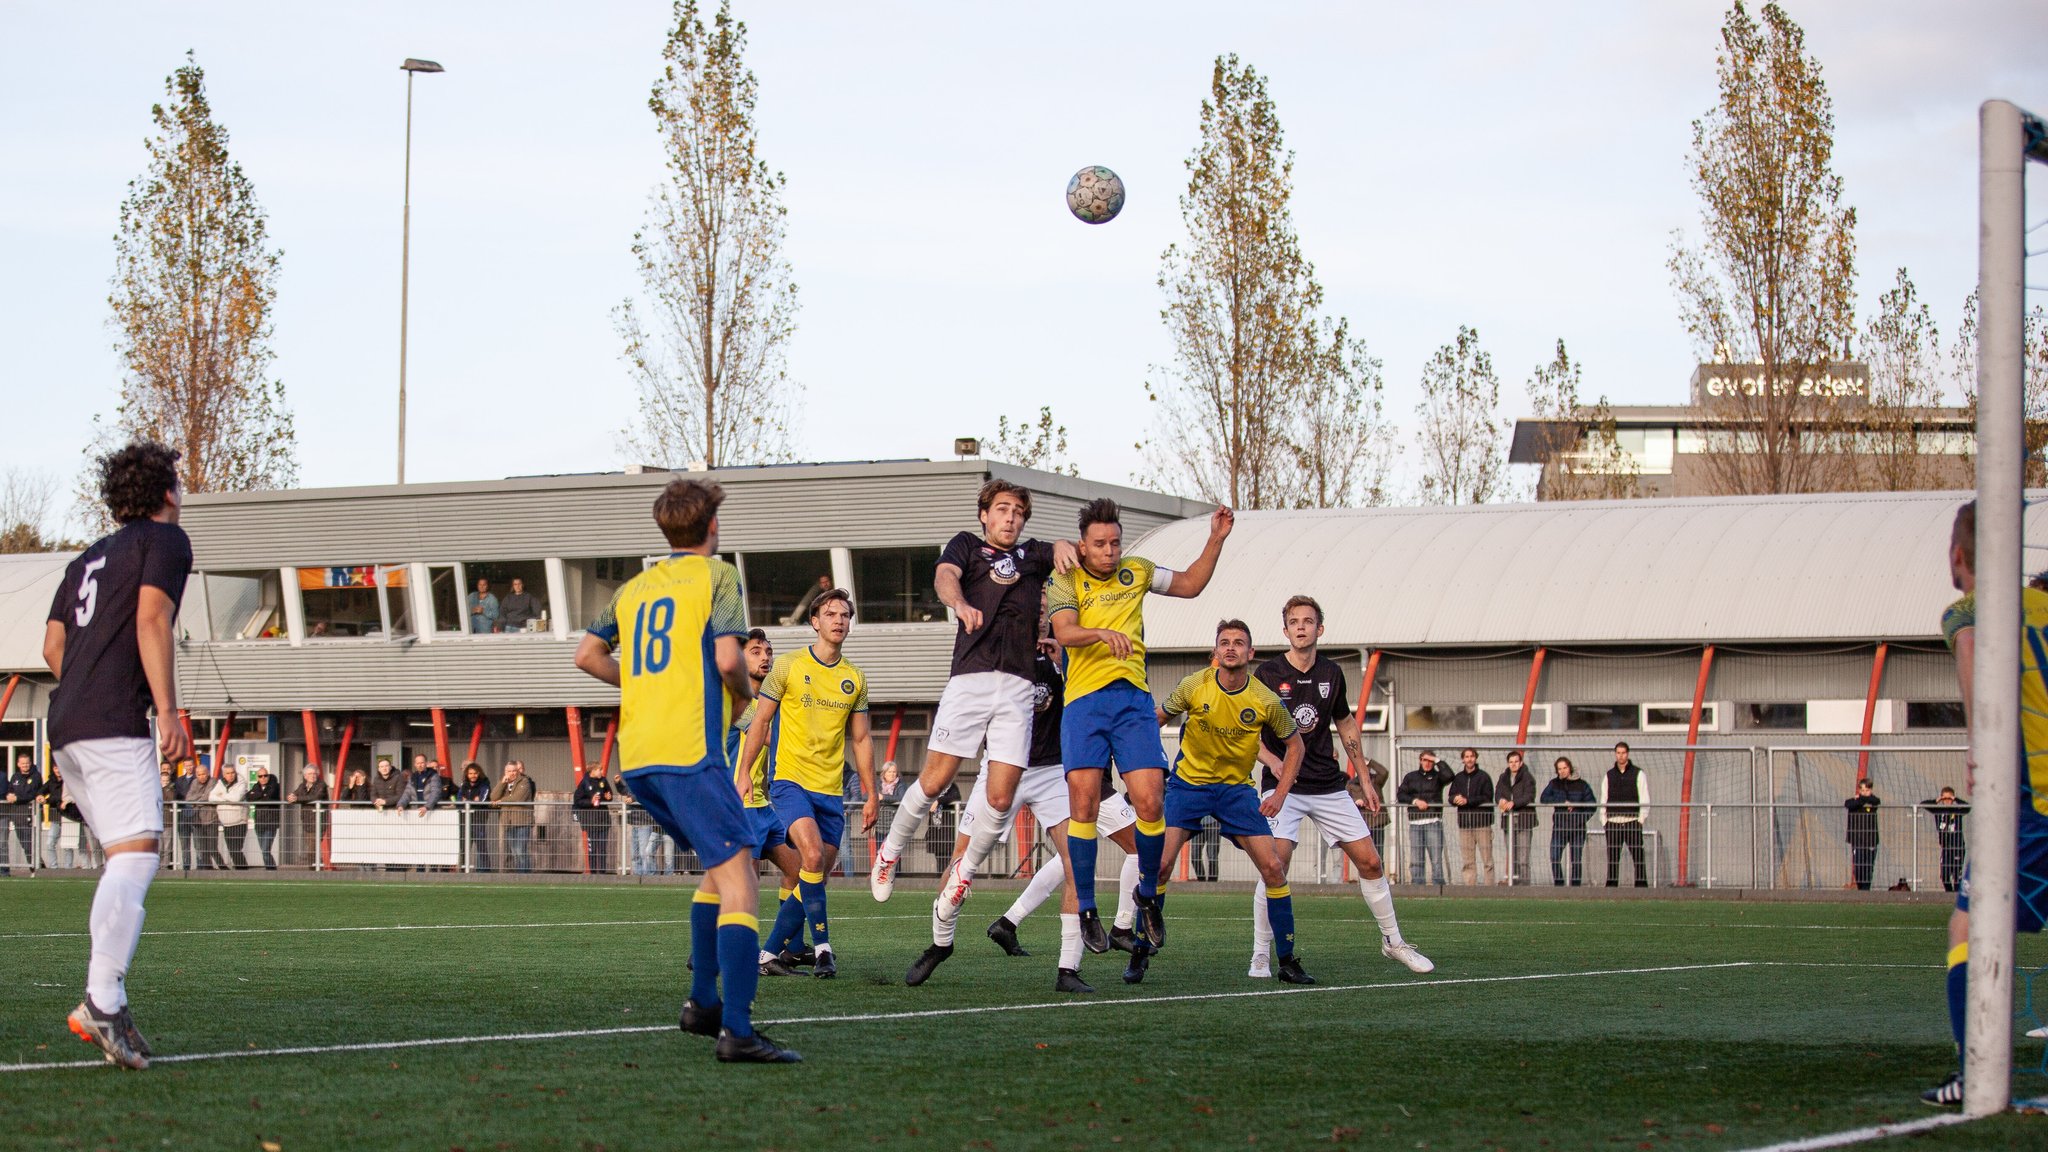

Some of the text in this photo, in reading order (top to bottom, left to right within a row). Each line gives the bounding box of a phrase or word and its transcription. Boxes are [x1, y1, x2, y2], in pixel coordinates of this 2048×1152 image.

[75, 555, 107, 628] 5
[1099, 590, 1137, 602] solutions
[632, 596, 675, 677] 18
[816, 698, 853, 711] solutions
